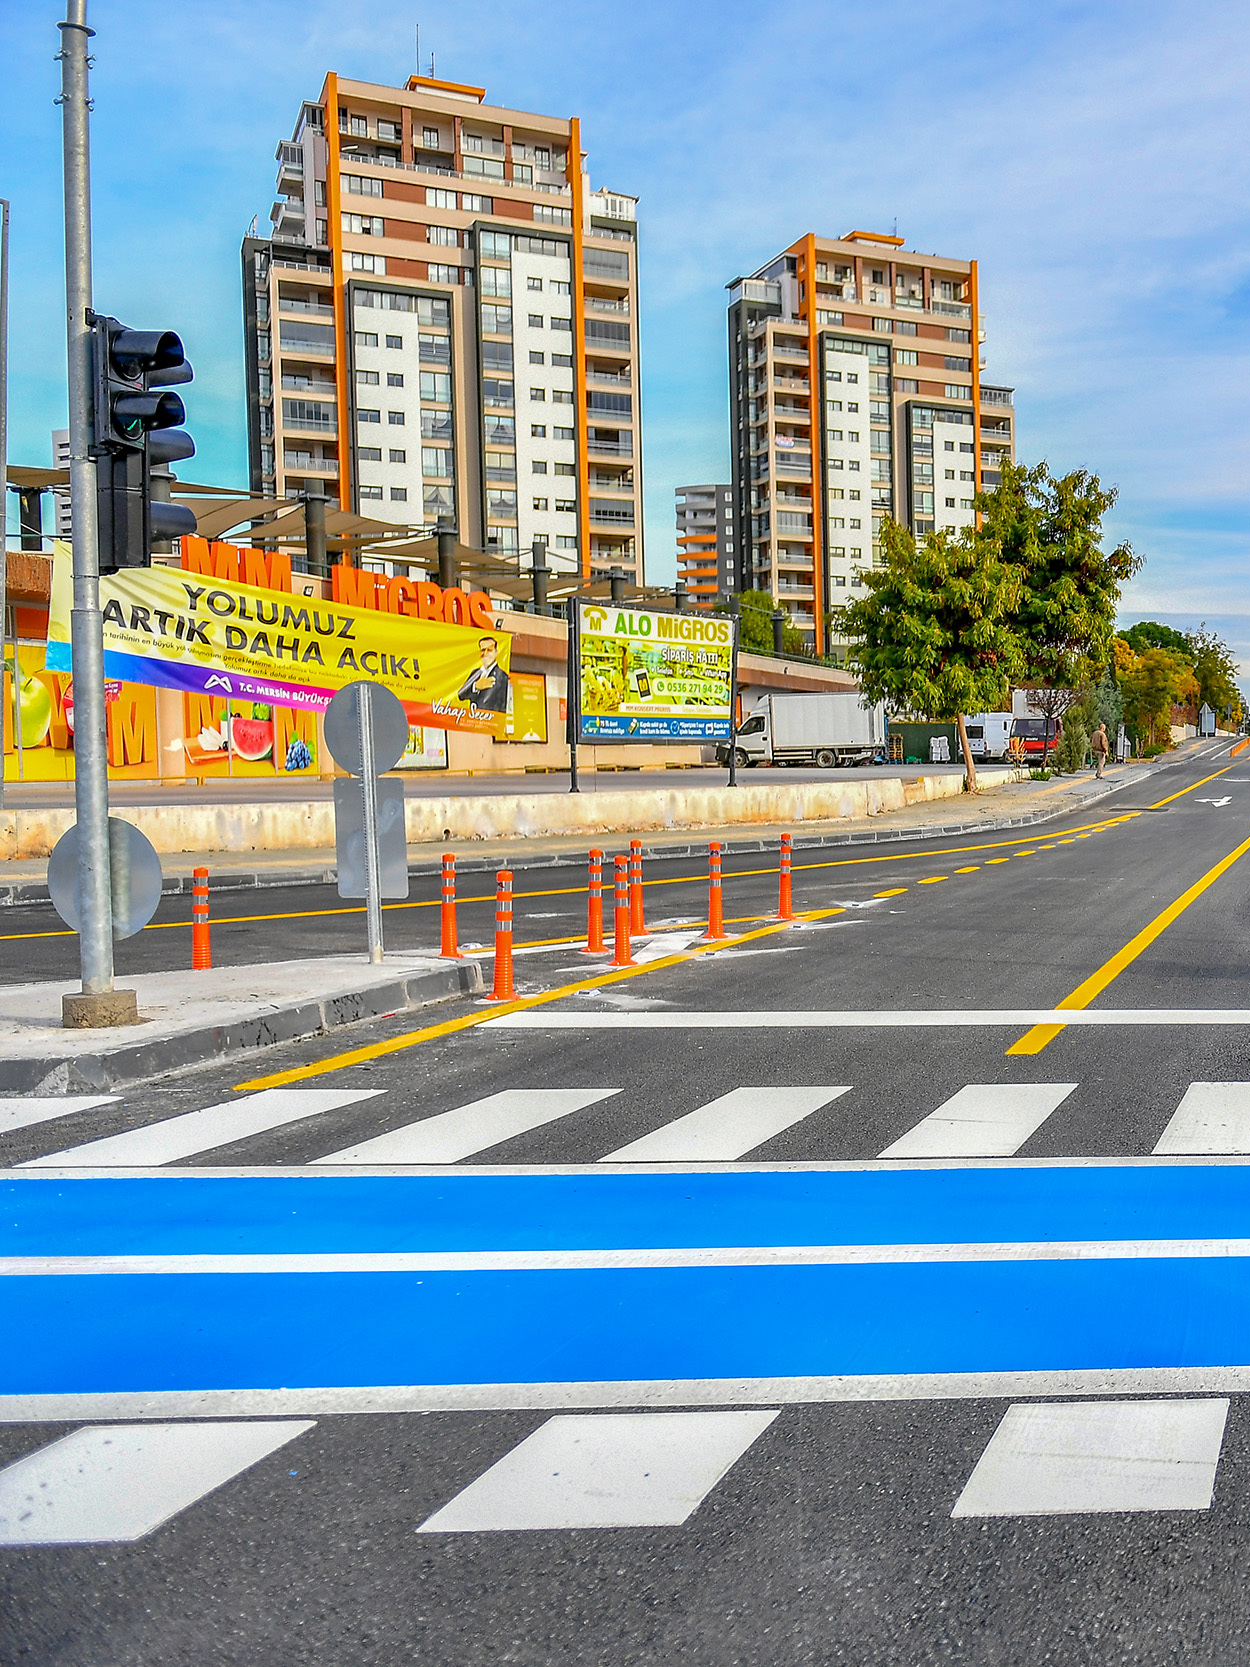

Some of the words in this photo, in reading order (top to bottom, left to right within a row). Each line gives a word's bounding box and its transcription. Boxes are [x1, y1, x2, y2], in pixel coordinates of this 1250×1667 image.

[181, 582, 356, 641] YOLUMUZ
[614, 612, 652, 637] ALO
[102, 598, 212, 646] ARTIK
[225, 624, 325, 667] DAHA
[336, 646, 421, 680] AÇIK!
[109, 631, 140, 643] tarihinin
[152, 639, 174, 650] büyük
[239, 682, 255, 693] T.C.
[256, 685, 290, 700] MERSİN
[291, 691, 333, 707] BÜYÜKŞ
[667, 682, 687, 692] 0536
[688, 683, 701, 693] 271
[702, 684, 712, 694] 94
[714, 684, 724, 694] 29
[432, 697, 467, 725] Vahap
